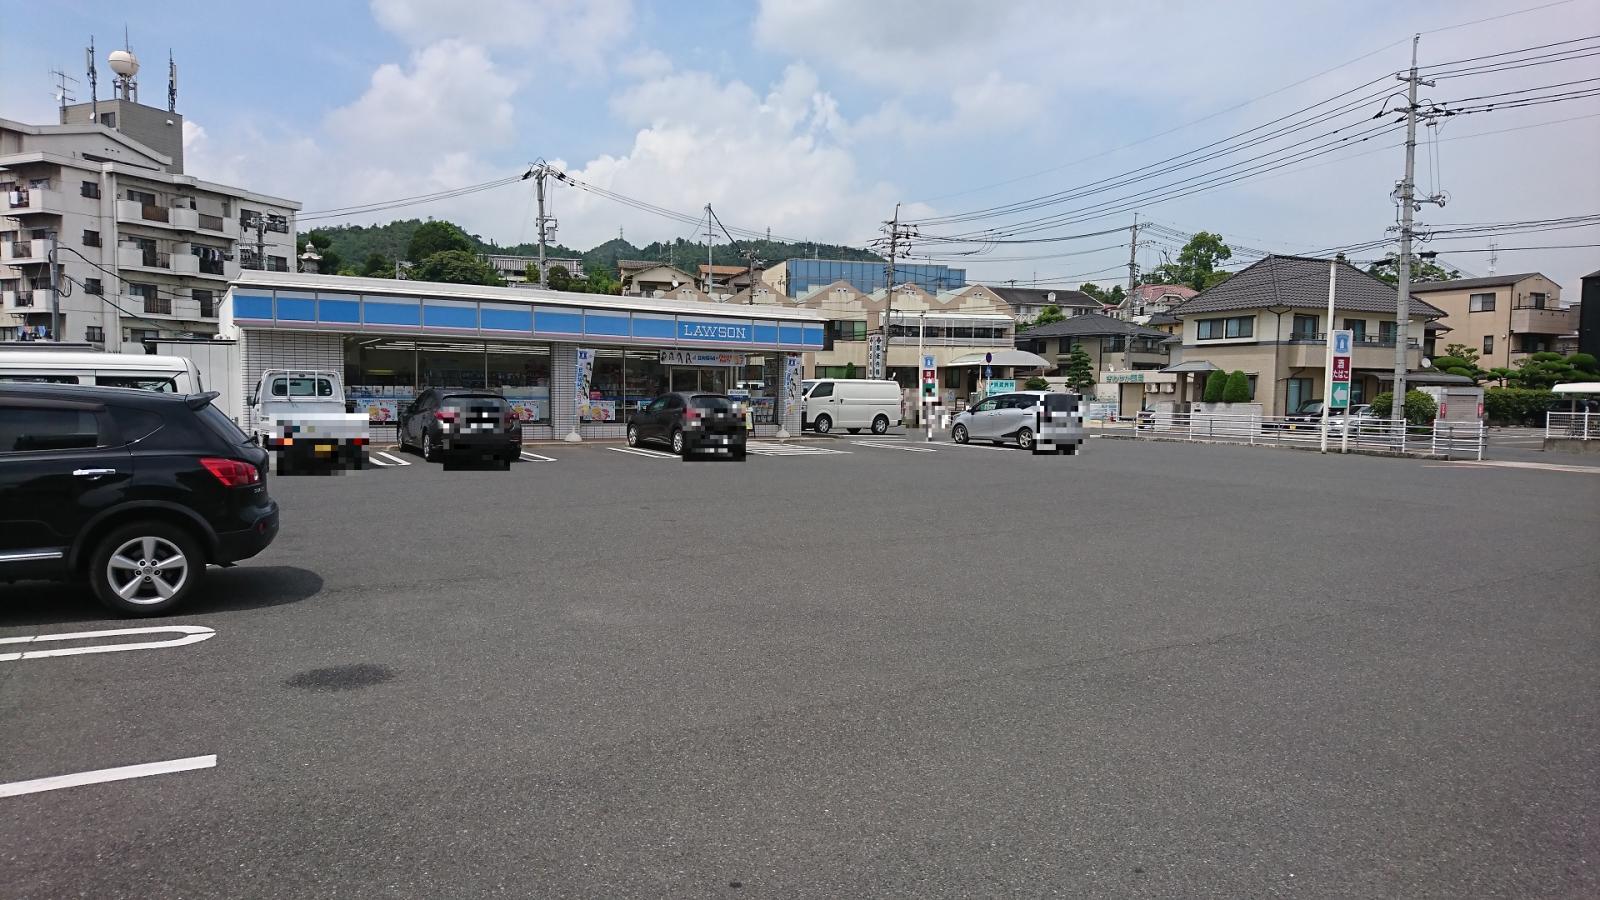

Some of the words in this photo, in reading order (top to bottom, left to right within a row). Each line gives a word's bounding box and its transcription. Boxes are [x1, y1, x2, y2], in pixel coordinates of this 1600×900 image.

[684, 324, 747, 339] LAWSON
[1332, 370, 1349, 379] たばこ
